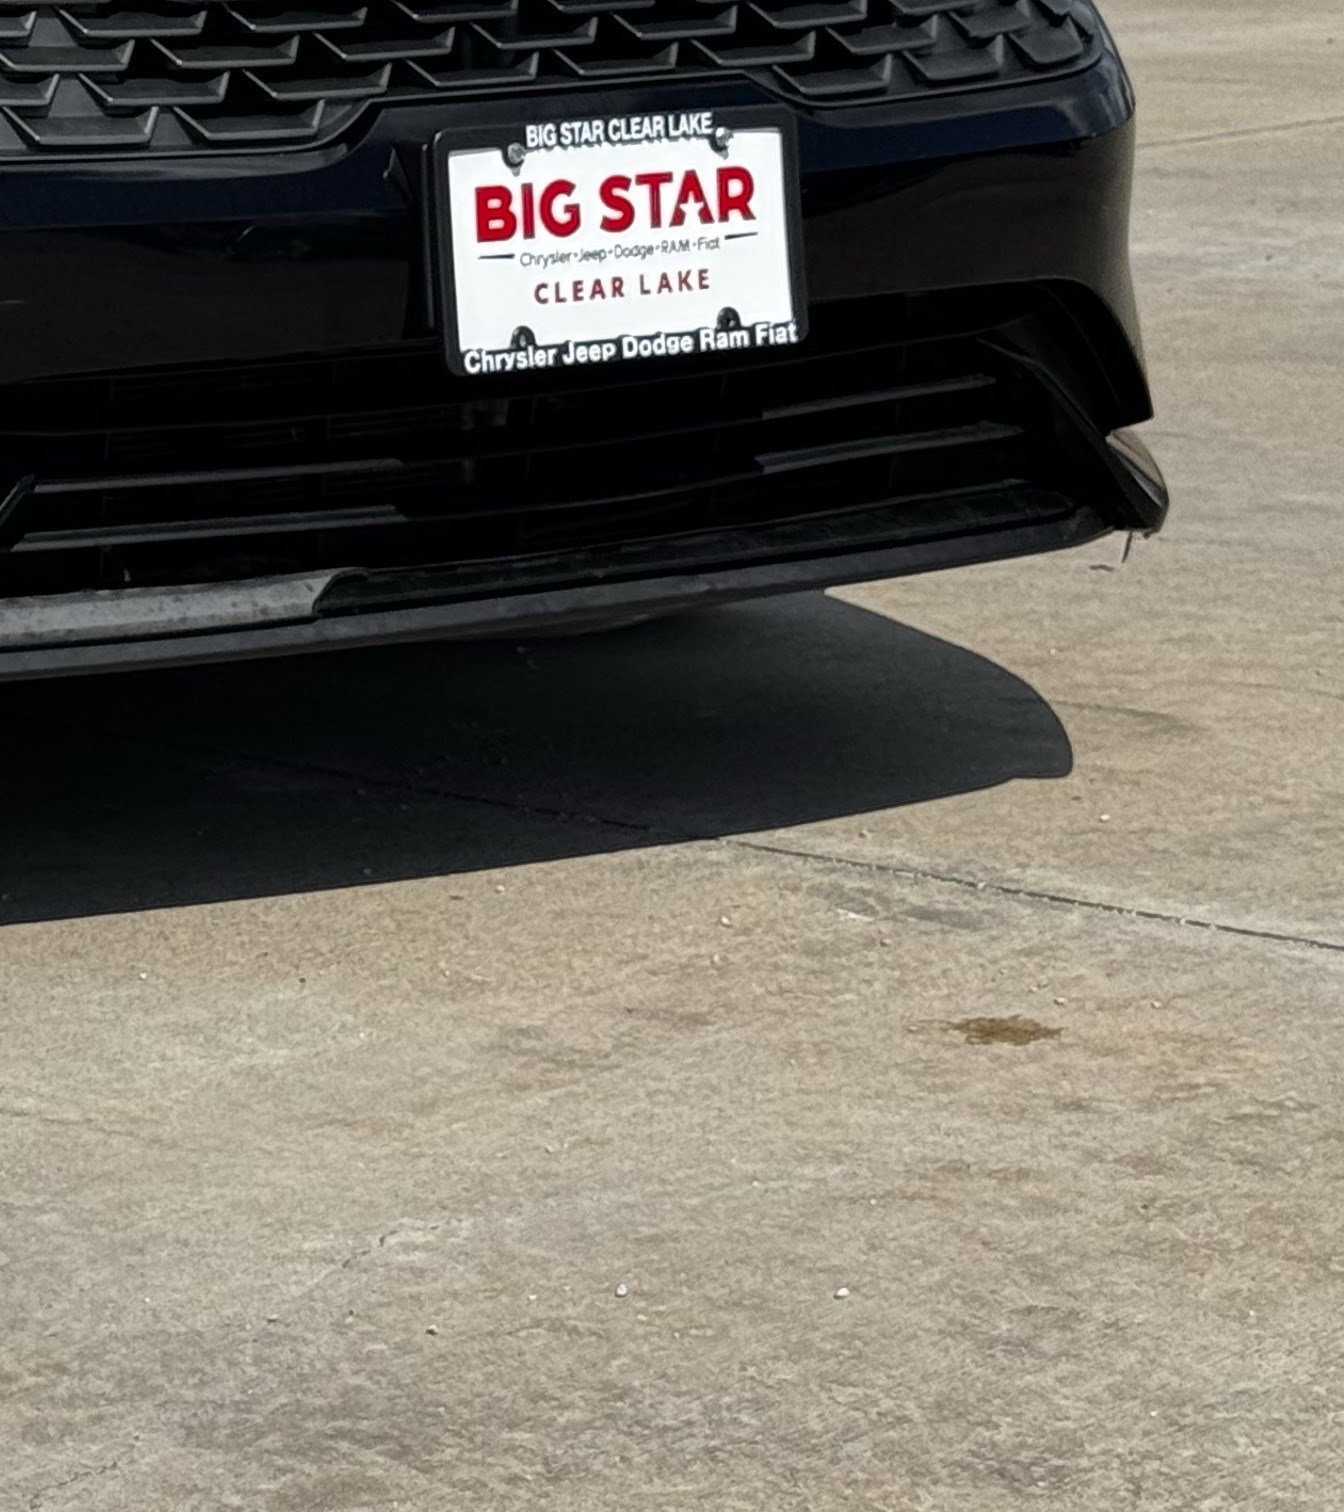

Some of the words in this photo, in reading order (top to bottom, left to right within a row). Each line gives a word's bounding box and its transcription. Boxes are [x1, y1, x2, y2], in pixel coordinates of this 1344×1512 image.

[525, 124, 559, 149] BIG
[560, 120, 605, 145] STAR
[608, 115, 666, 141] CLEAR
[667, 111, 712, 136] LAKE
[474, 179, 581, 244] BIG
[599, 165, 757, 234] STAR
[533, 276, 625, 305] CLEAR
[639, 268, 710, 296] LAKE
[463, 343, 558, 375] Chrysler
[561, 339, 615, 365] Jeep
[622, 332, 693, 360] Dodge
[699, 326, 752, 351] Ram
[755, 319, 799, 346] Fiat
